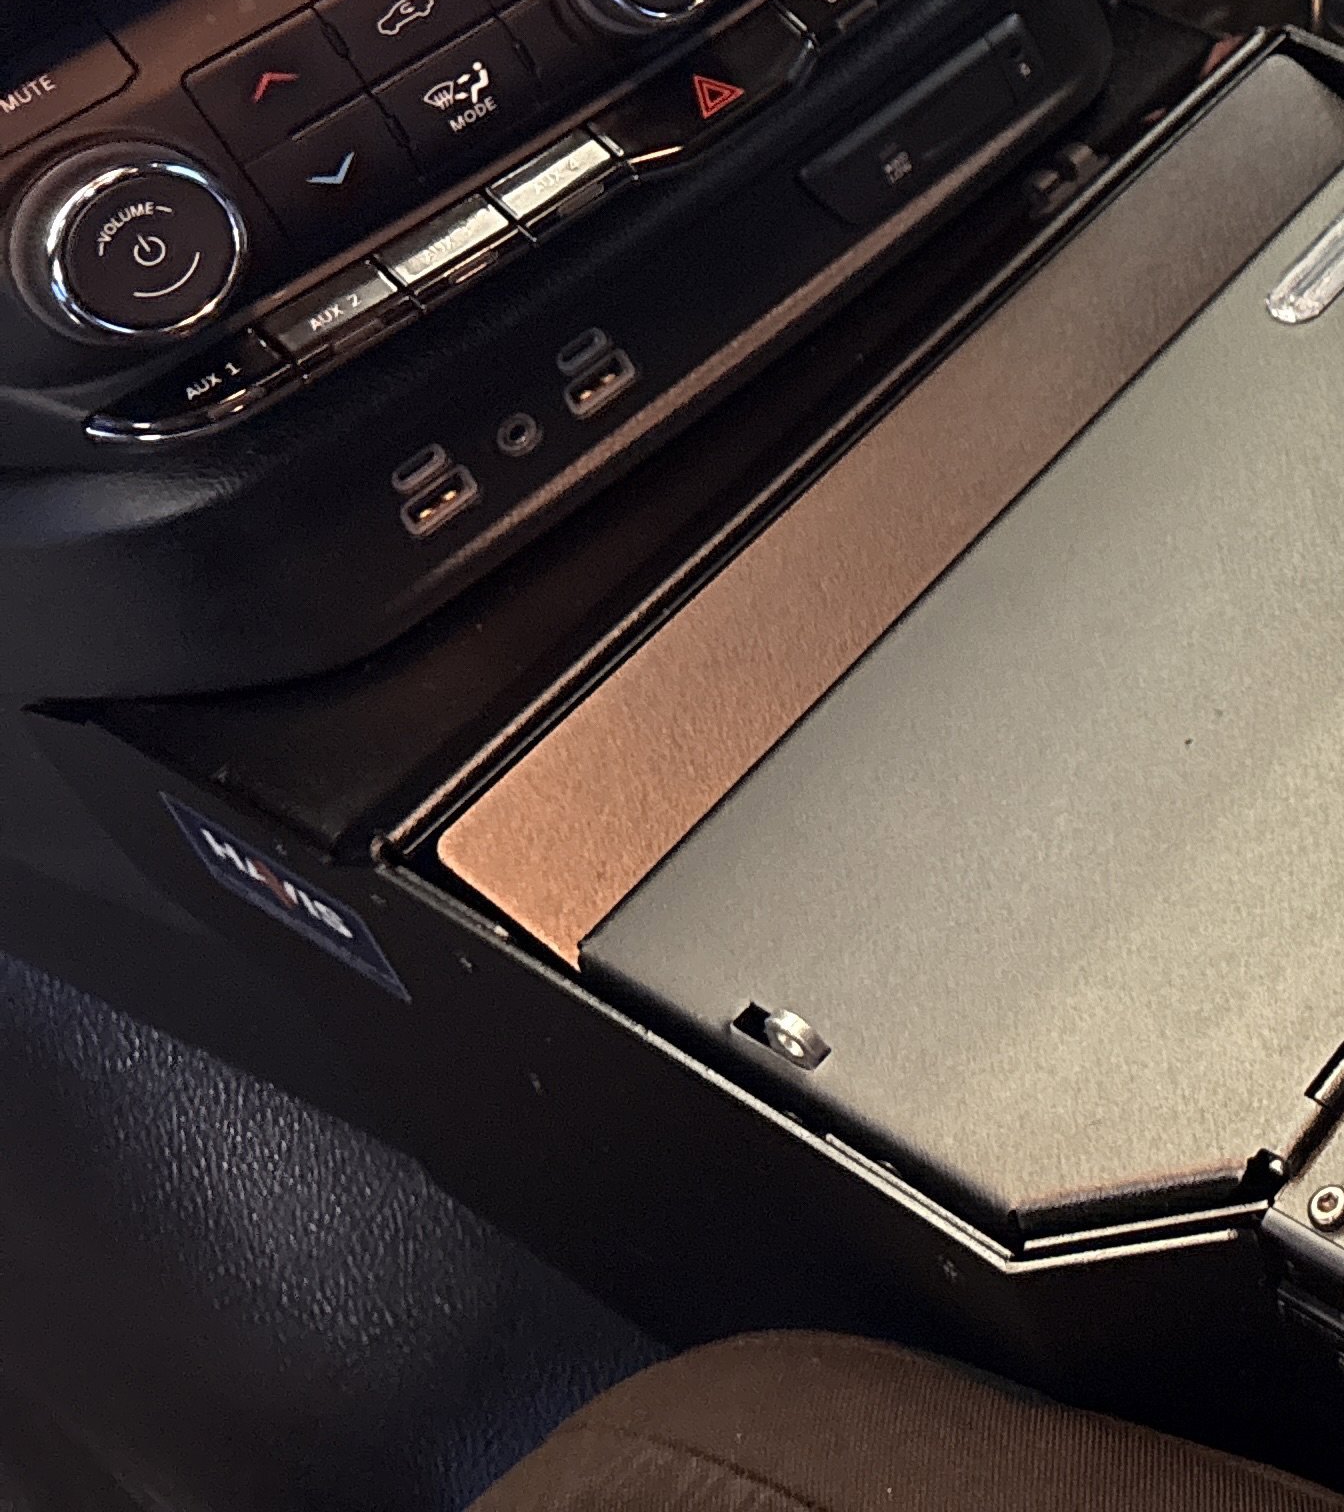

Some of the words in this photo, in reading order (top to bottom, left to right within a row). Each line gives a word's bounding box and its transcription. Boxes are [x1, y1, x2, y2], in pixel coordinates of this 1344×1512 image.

[0, 74, 56, 113] MUTE
[449, 95, 498, 133] MODE
[97, 201, 155, 243] VOLUME
[309, 305, 345, 332] AUX
[349, 293, 363, 309] 2
[185, 373, 222, 401] AUX
[225, 362, 241, 378] 1
